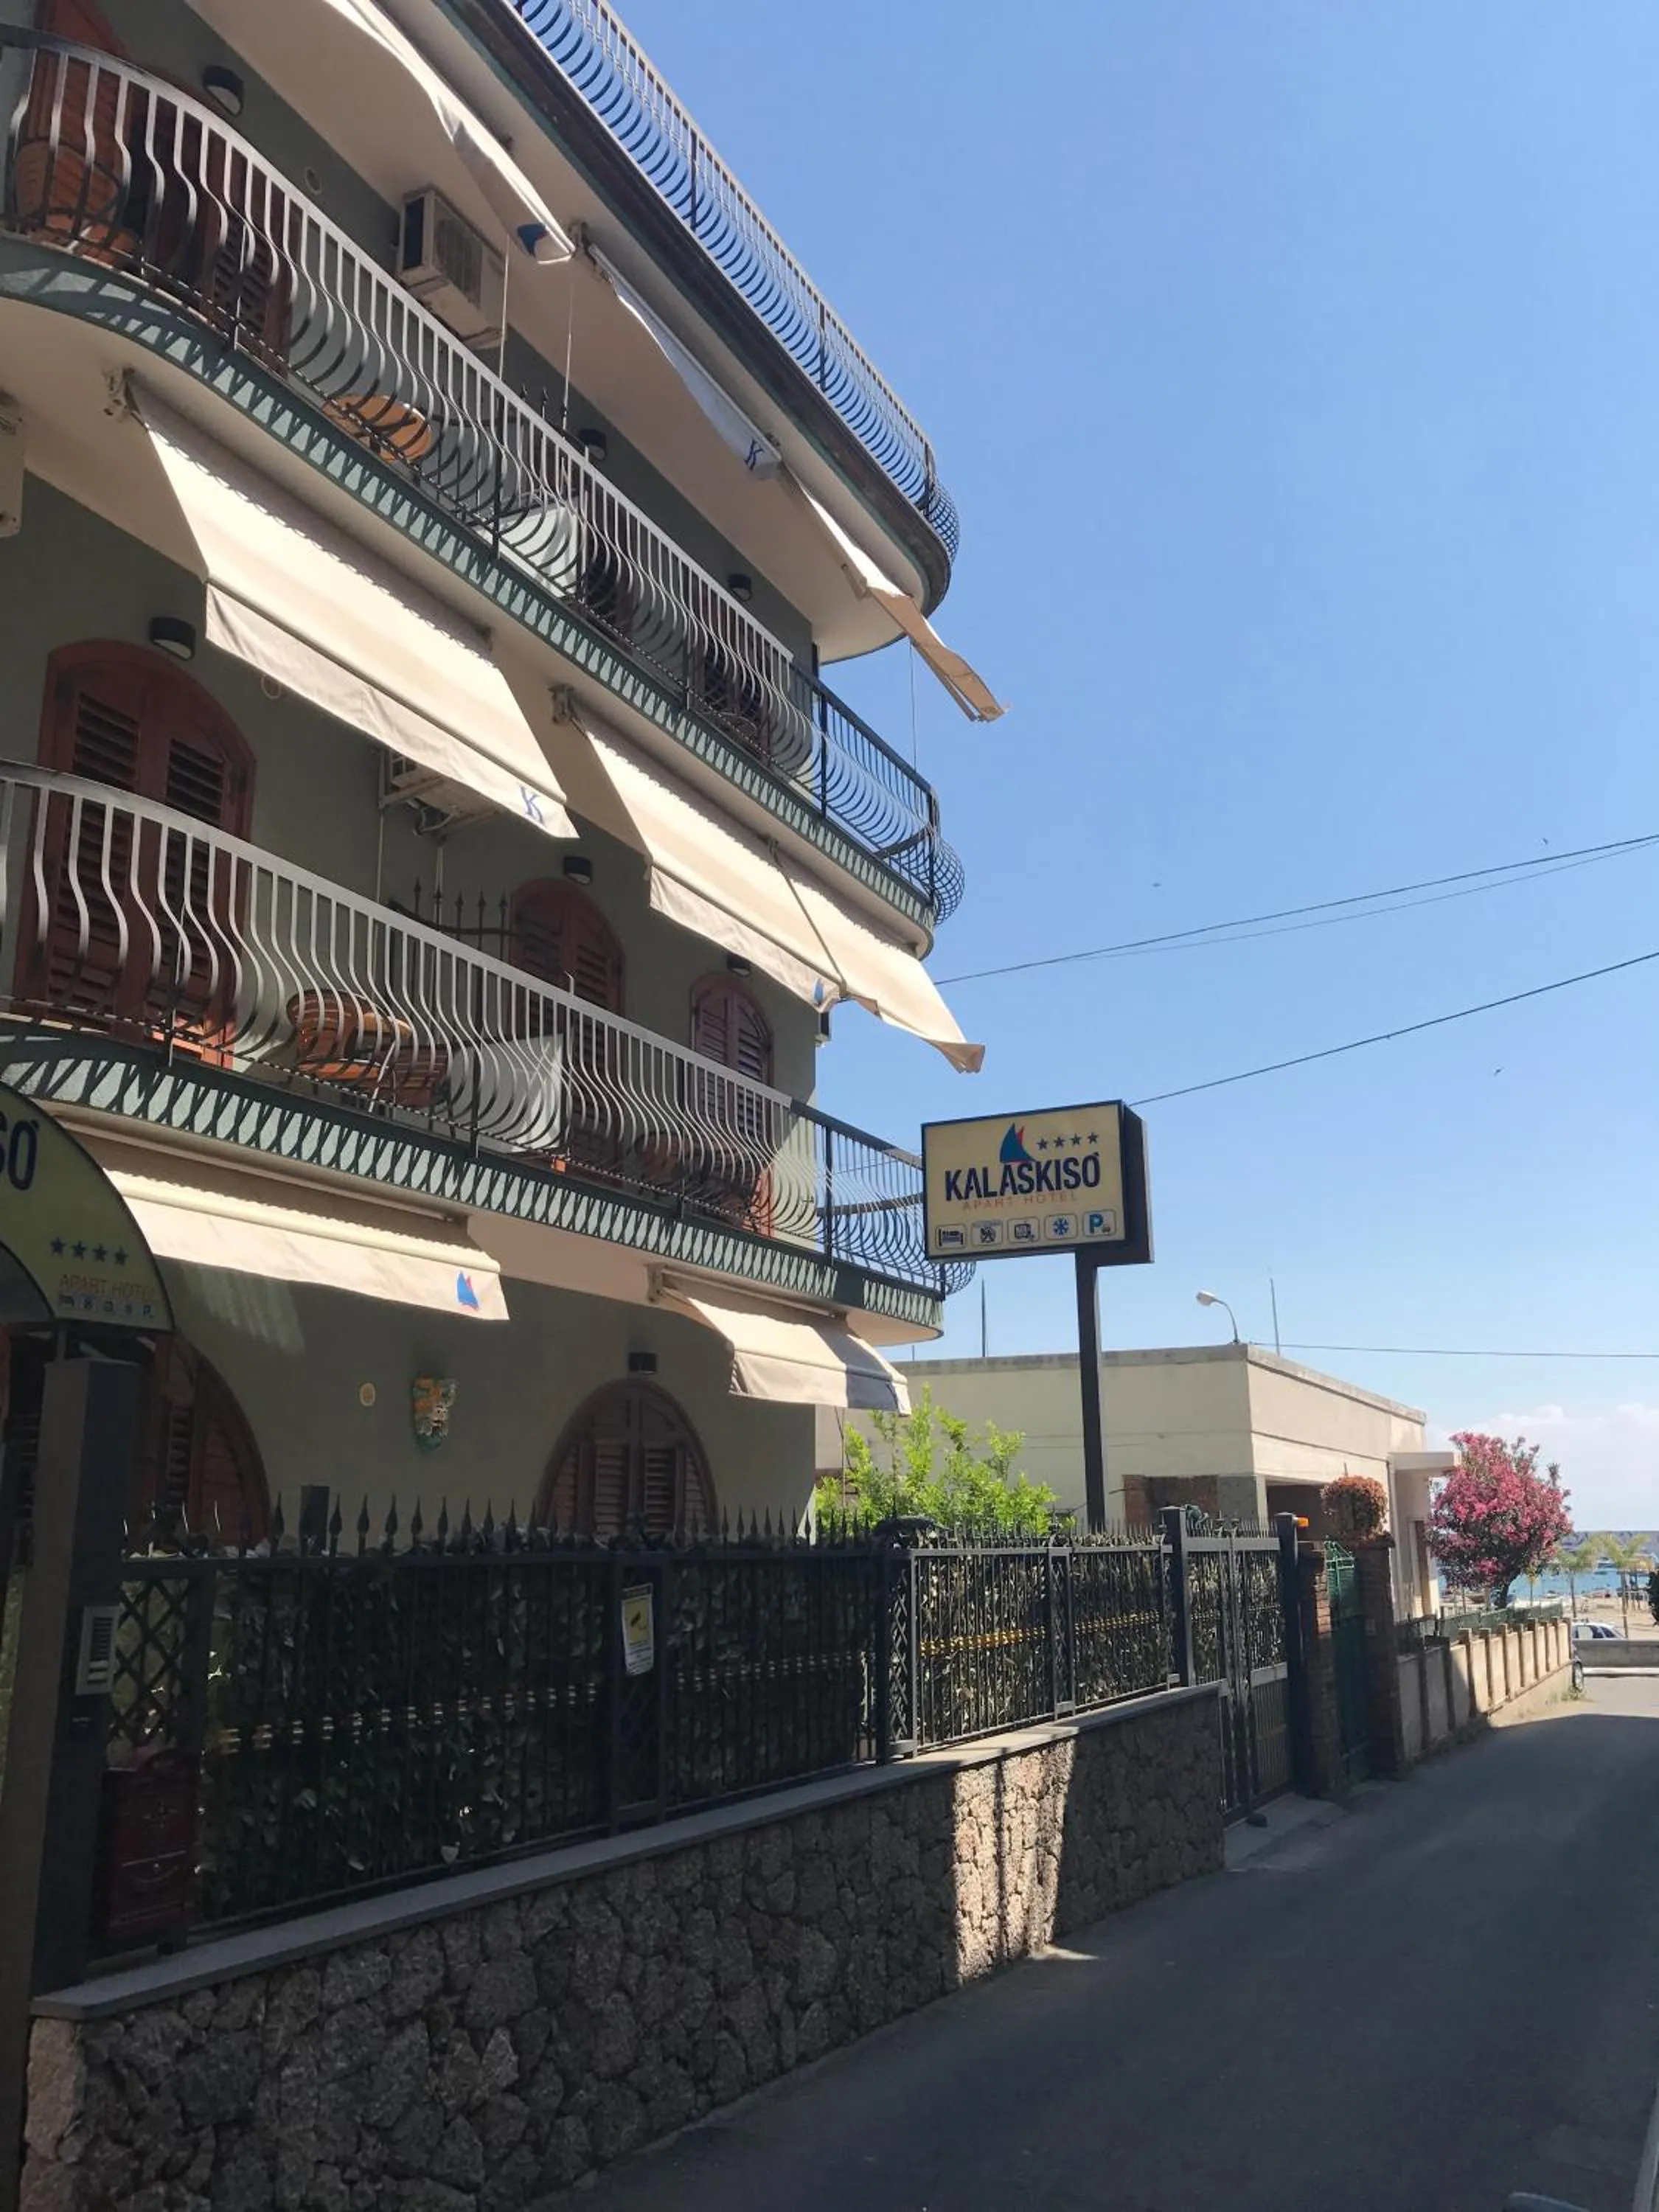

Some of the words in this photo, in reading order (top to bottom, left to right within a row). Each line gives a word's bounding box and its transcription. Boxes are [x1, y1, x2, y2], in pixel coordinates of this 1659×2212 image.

[520, 786, 543, 824] K
[1024, 1191, 1077, 1204] HOTEL
[60, 1274, 107, 1295] APART
[112, 1281, 156, 1301] HOTEL
